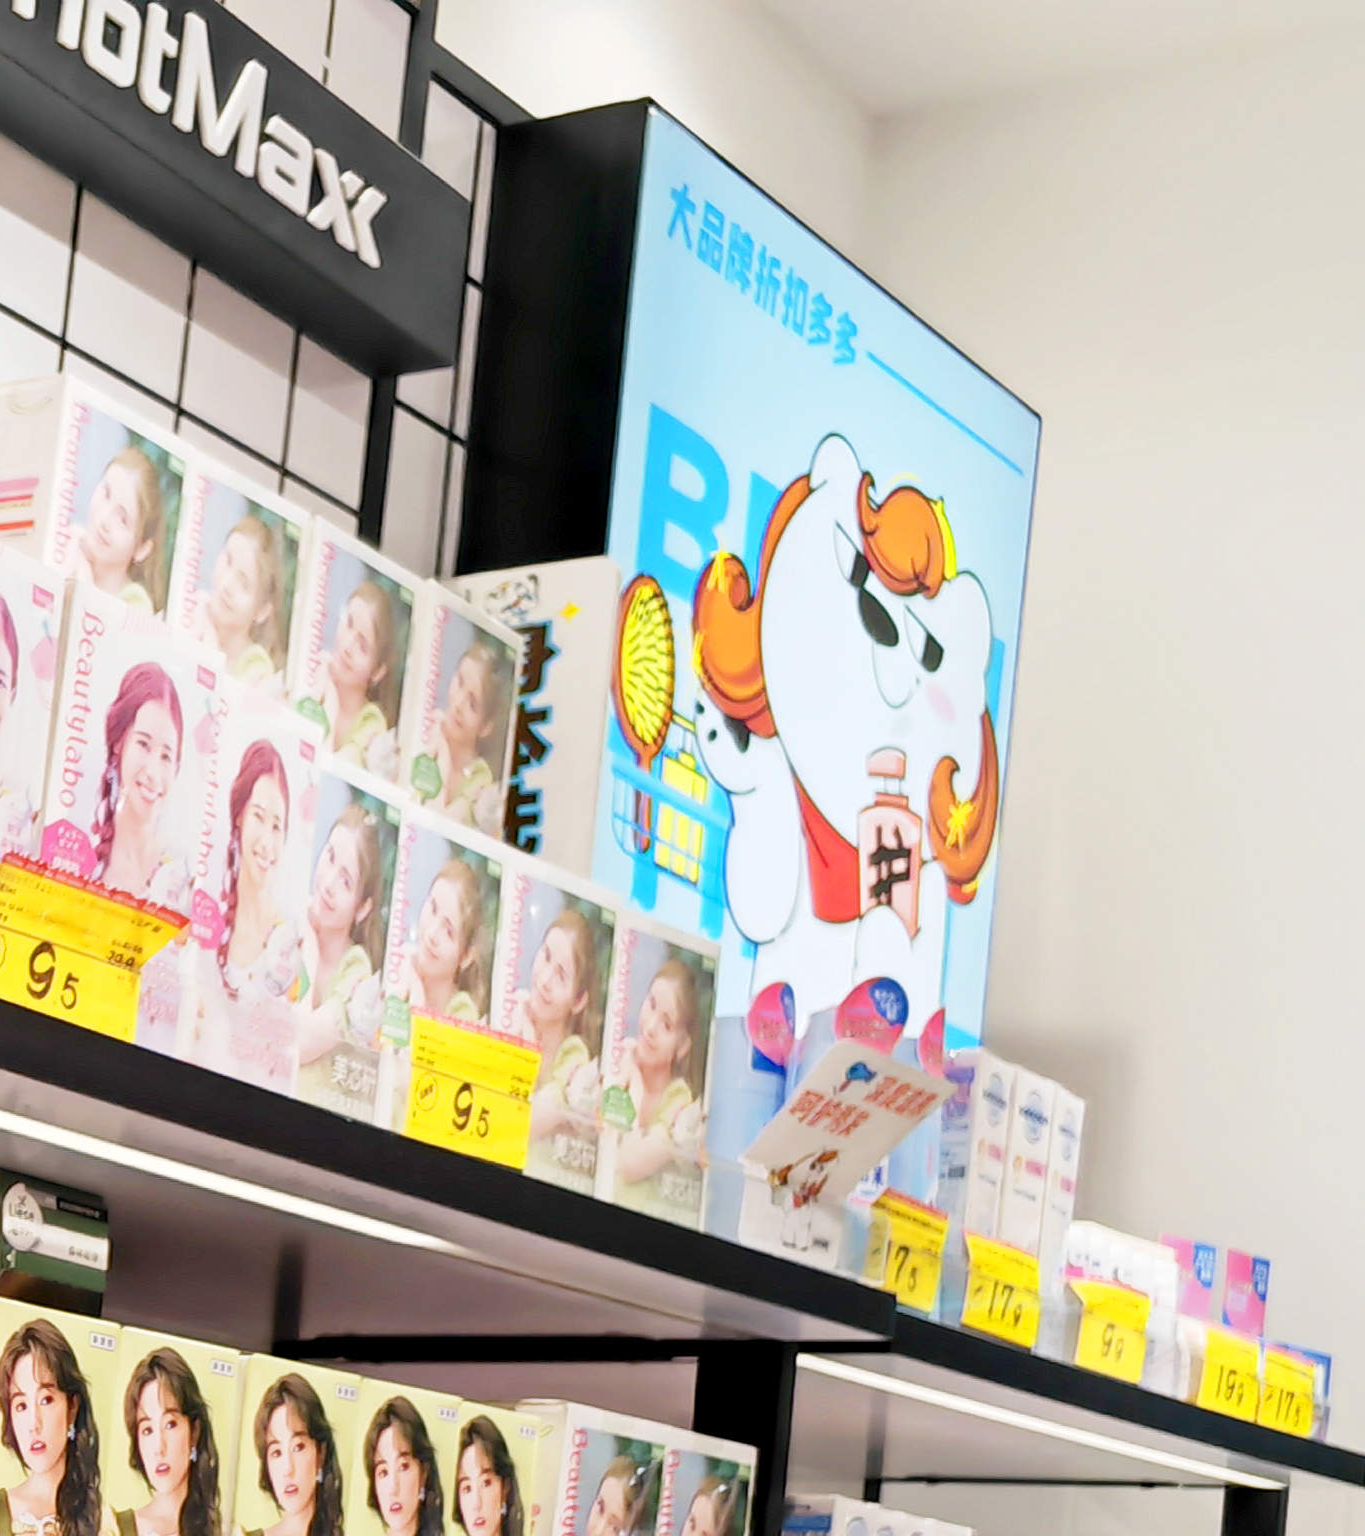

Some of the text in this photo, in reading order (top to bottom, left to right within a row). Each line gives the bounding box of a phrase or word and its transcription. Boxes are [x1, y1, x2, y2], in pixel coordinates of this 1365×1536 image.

[667, 182, 859, 365] 大品牌折扣多多
[58, 608, 105, 810] Beautylabo
